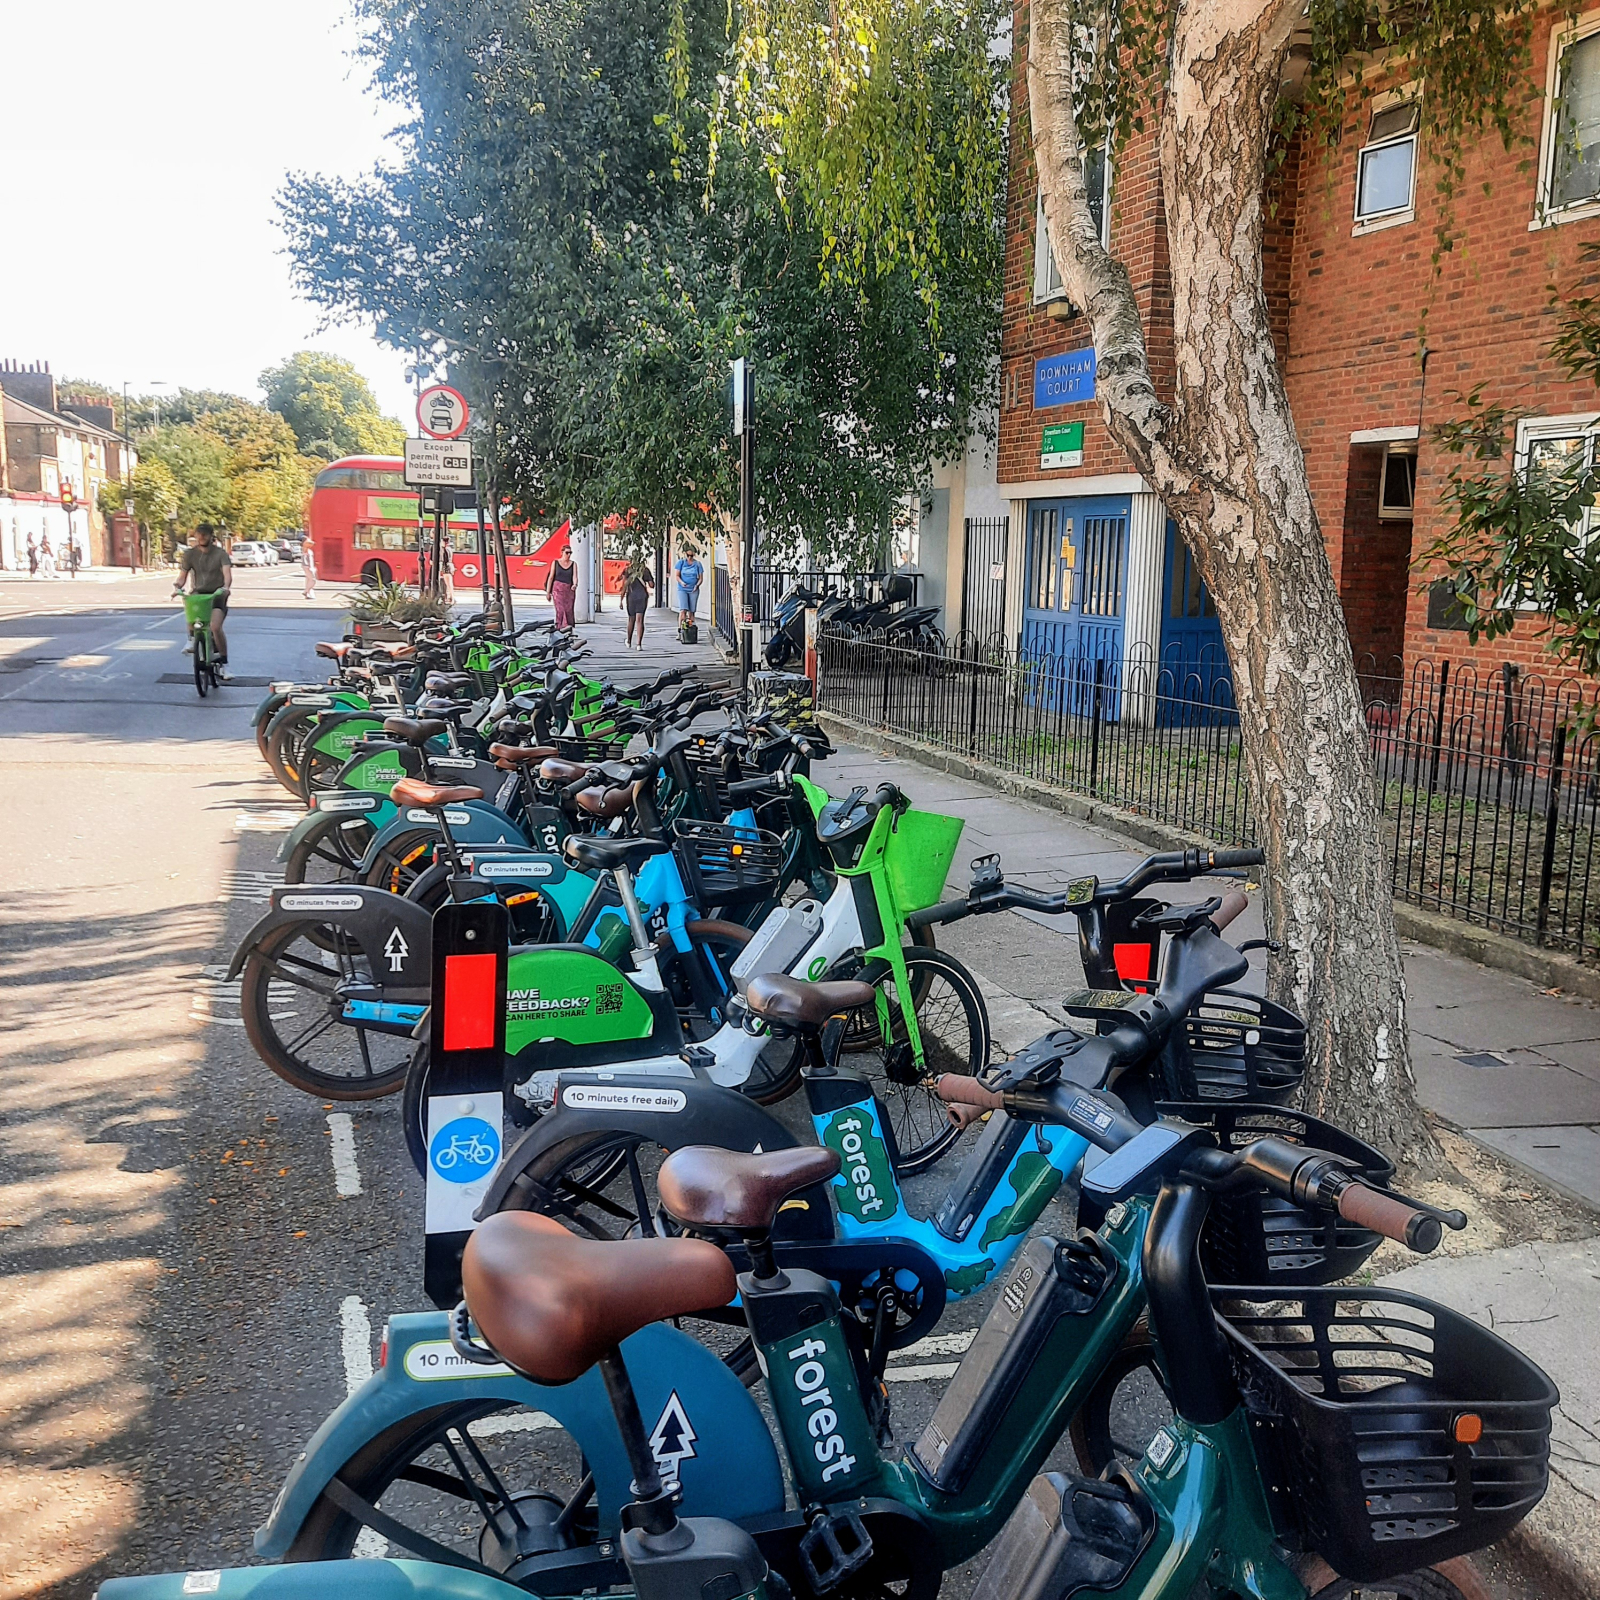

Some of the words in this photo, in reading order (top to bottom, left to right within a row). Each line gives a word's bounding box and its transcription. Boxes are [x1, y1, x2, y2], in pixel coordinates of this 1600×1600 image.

[1040, 359, 1091, 381] DOWNHAM
[1047, 377, 1081, 396] COURT
[424, 443, 453, 452] Except
[410, 453, 439, 461] permit
[409, 462, 441, 470] holders
[444, 458, 467, 468] CBE
[435, 473, 460, 481] buses
[341, 899, 358, 907] daily
[506, 997, 590, 1012] EEDBACK?
[525, 1011, 546, 1020] HERE
[570, 1092, 584, 1101] 10
[587, 1092, 629, 1103] minutes
[631, 1095, 652, 1104] free
[655, 1096, 679, 1107] daily
[838, 1117, 884, 1215] forest
[419, 1353, 439, 1366] 10
[788, 1338, 857, 1483] forest
